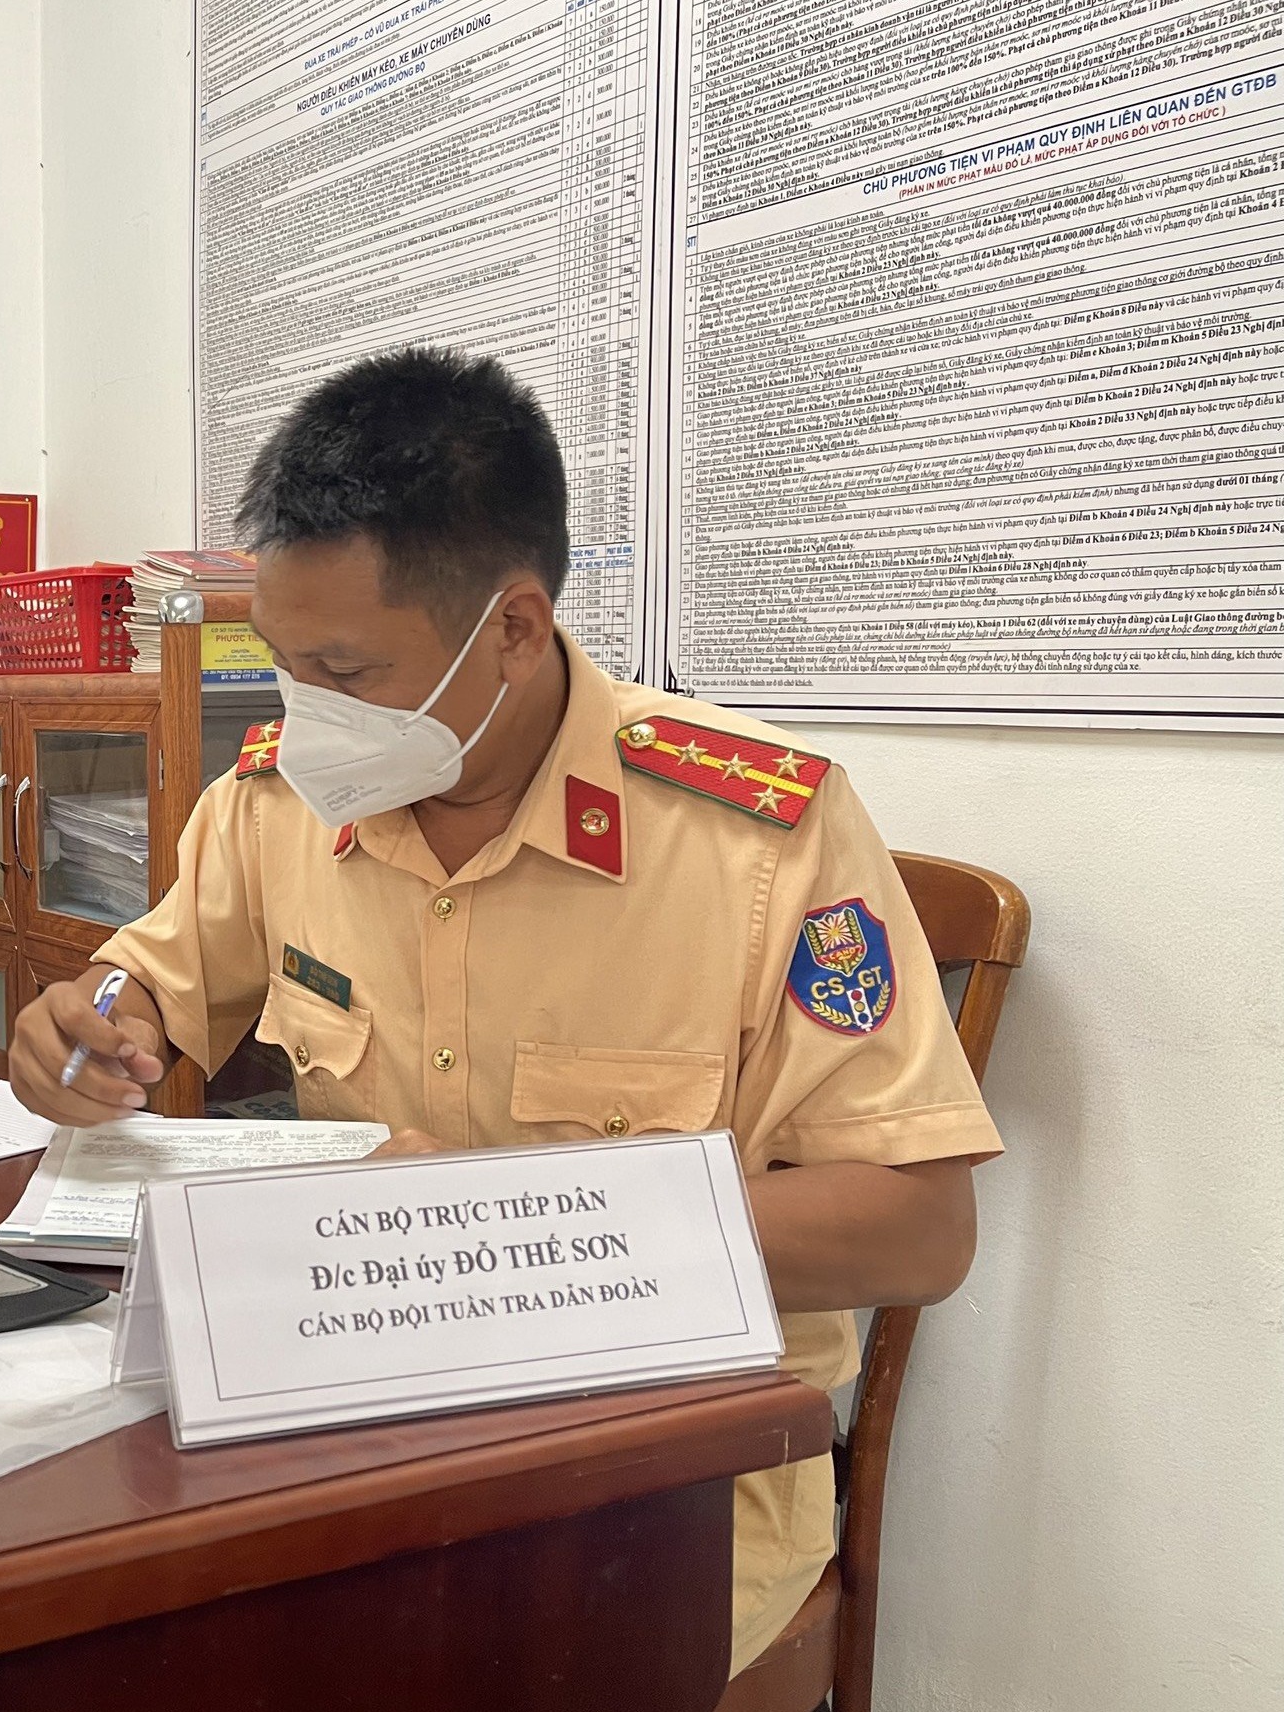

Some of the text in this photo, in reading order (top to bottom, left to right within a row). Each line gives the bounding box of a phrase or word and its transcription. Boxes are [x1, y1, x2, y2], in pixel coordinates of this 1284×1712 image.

[399, 51, 410, 64] XE
[863, 73, 1277, 195] CHỦ PHƯƠNG TIỆN VI PHẠM QUY ĐỊNH LIÊN QUAN ĐẾN GTĐB
[926, 182, 935, 192] IN
[1101, 130, 1129, 146] DỤNG
[1114, 486, 1140, 497] nhưng
[1216, 476, 1237, 487] dưới
[1239, 476, 1249, 485] 01
[1194, 613, 1216, 623] Giao
[315, 1186, 608, 1239] CÁN BỘ TRỰC TIẾP DÂN
[309, 1232, 631, 1291] Đ/c Đại úy ĐỖ THẾ SƠN
[298, 1310, 348, 1339] CÁN
[353, 1308, 385, 1335] BỘ
[389, 1303, 433, 1330] ĐỘI
[500, 1291, 547, 1315] TRA
[599, 1275, 661, 1303] ĐOÀN
